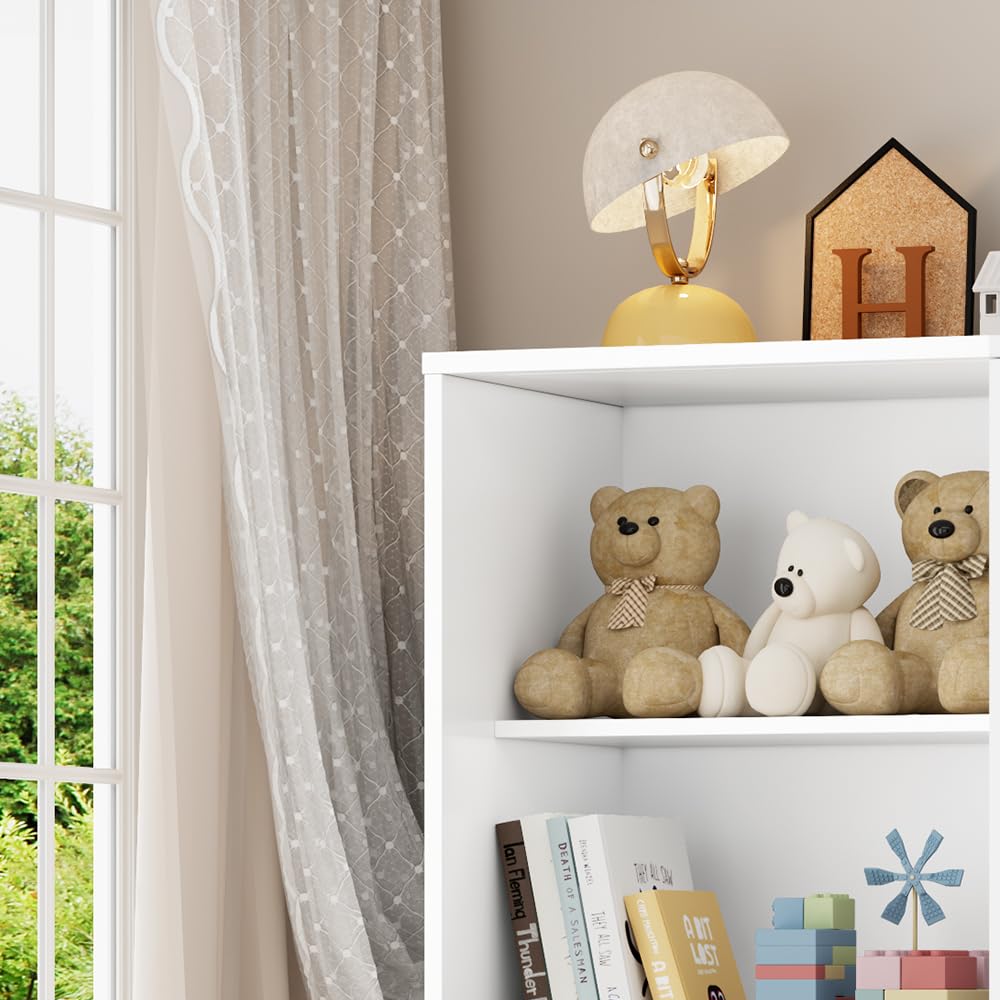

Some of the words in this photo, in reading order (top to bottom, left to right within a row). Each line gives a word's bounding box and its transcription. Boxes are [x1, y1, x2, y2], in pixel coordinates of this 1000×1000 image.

[831, 245, 936, 340] H
[504, 841, 525, 866] Ian
[558, 842, 572, 881] DEATH
[508, 868, 527, 921] Fleming
[566, 887, 575, 899] OF
[516, 922, 546, 996] Thunder
[570, 919, 588, 984] SALESMAN
[691, 942, 720, 967] LOST
